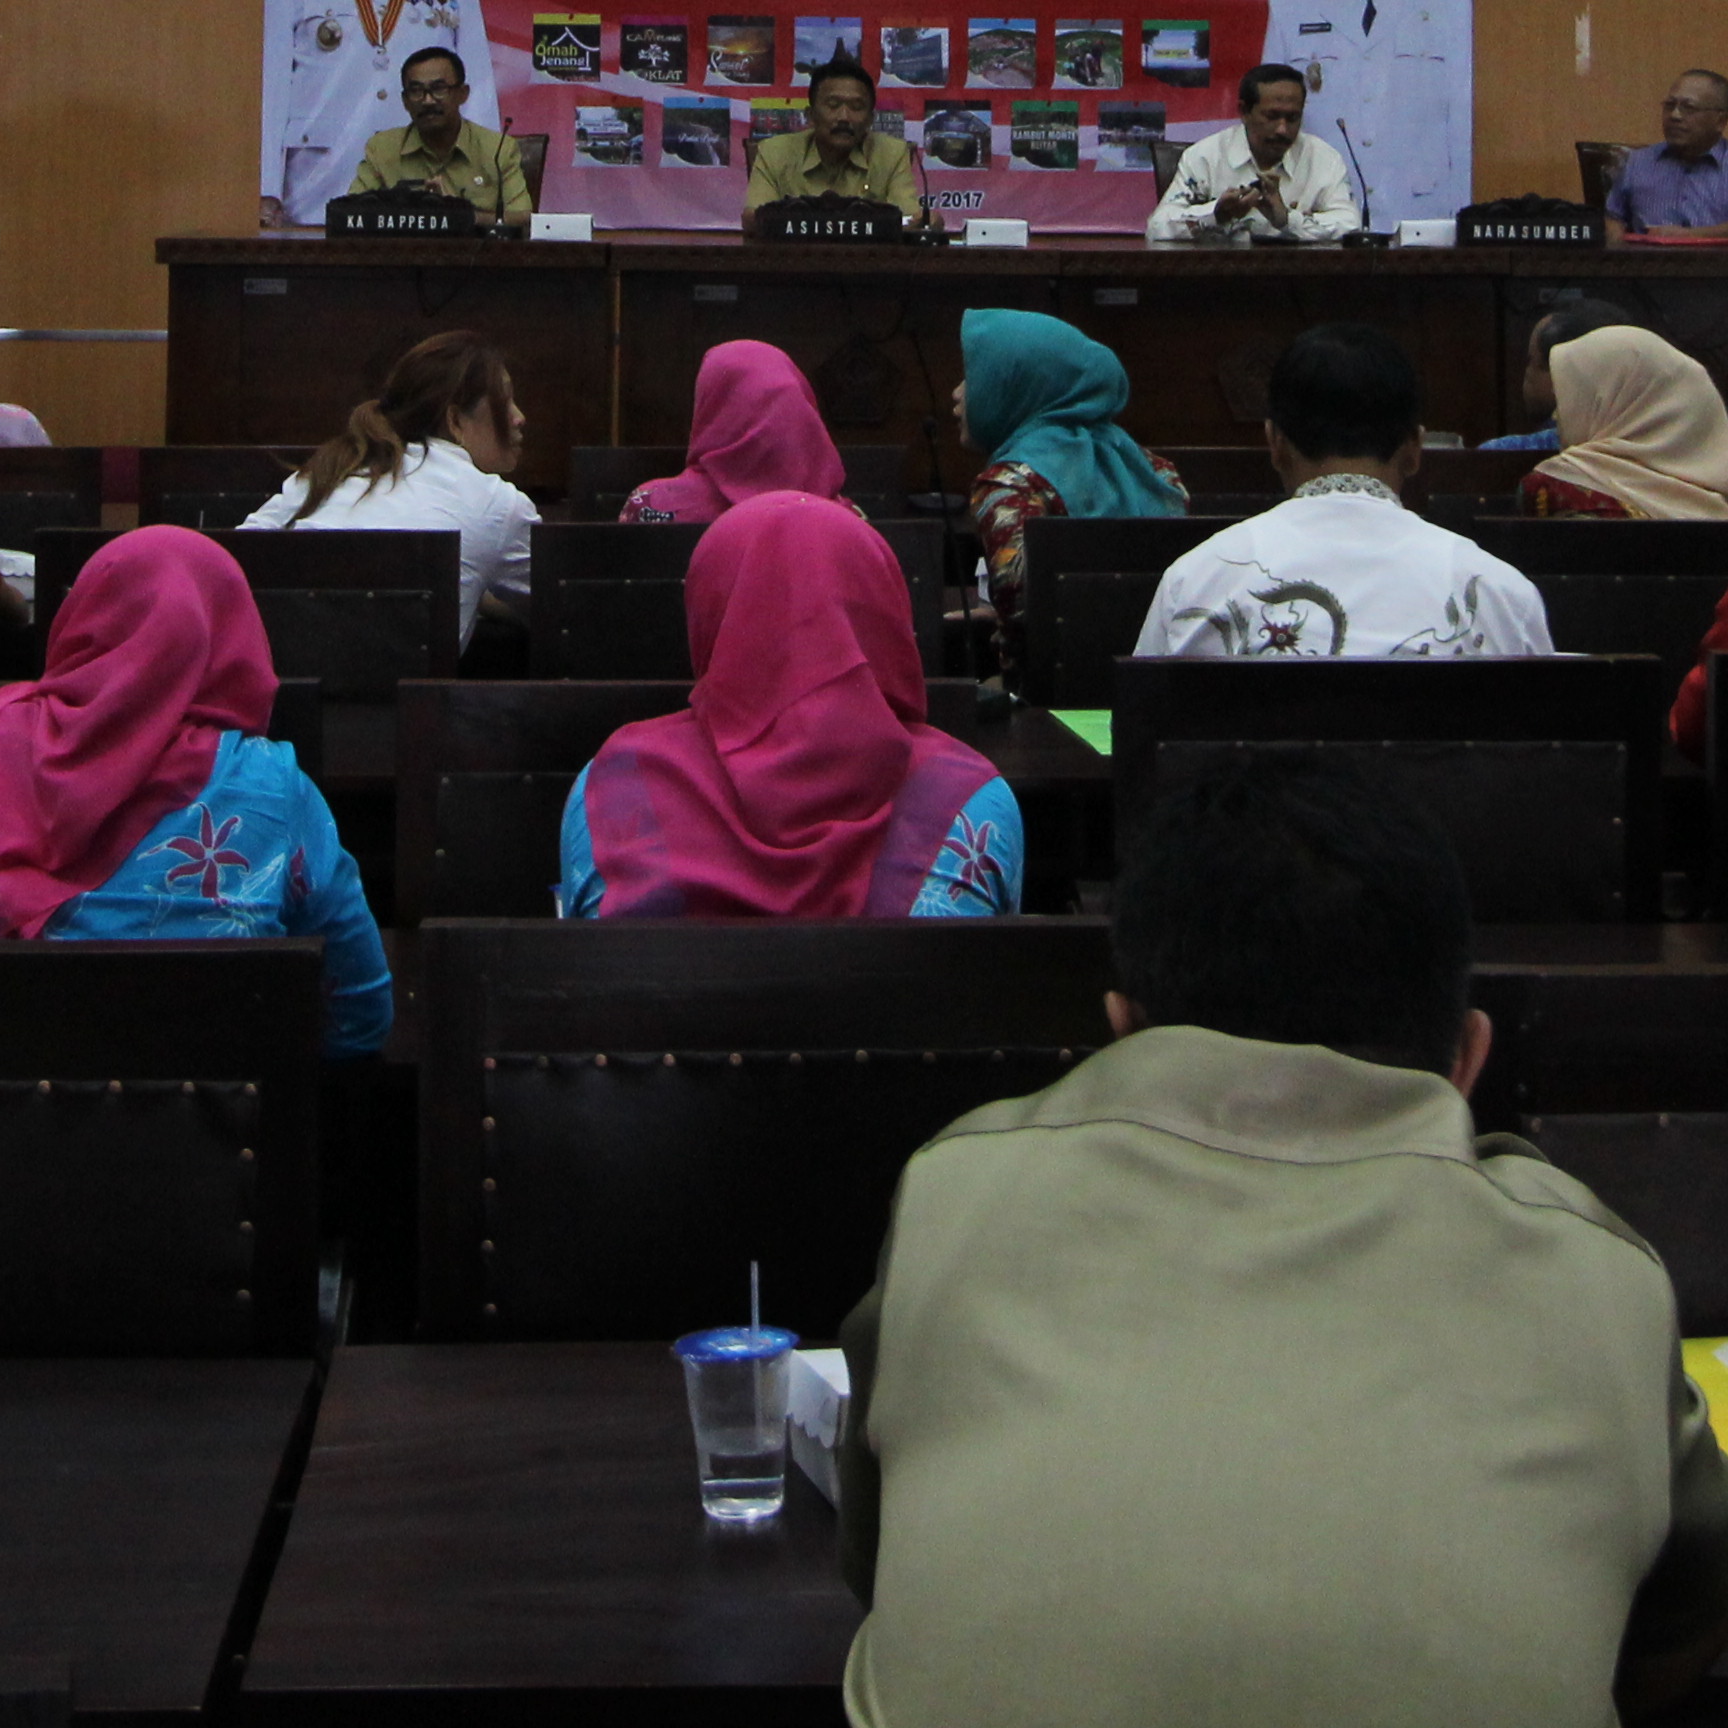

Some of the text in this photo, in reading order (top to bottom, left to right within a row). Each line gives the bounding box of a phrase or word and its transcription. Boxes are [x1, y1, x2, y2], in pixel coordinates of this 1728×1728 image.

[940, 190, 984, 209] 2017
[346, 215, 449, 230] KA BAPPEDA
[785, 220, 874, 236] ASISTEN
[1473, 224, 1591, 240] NARASUMBER
